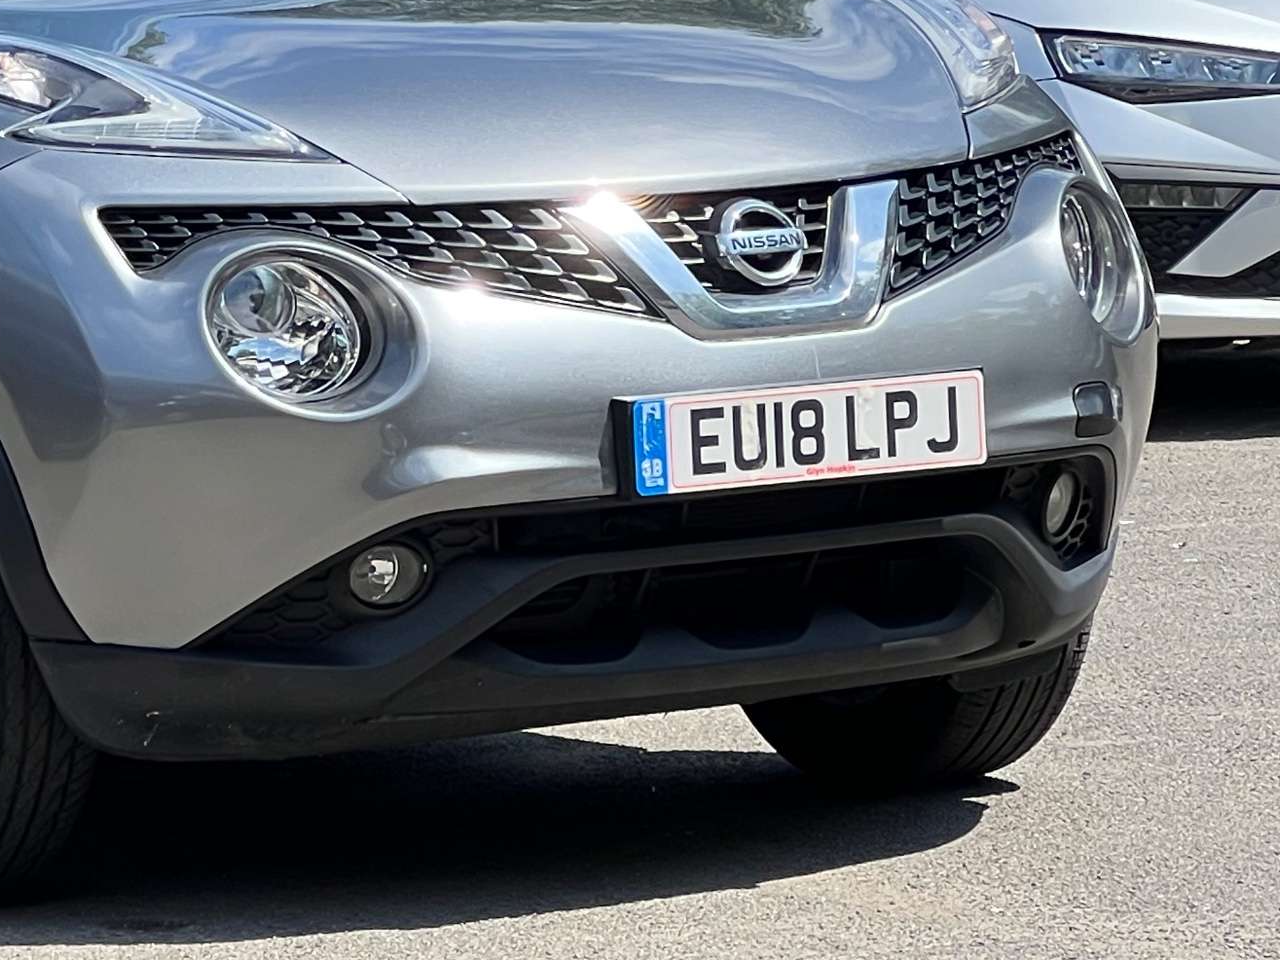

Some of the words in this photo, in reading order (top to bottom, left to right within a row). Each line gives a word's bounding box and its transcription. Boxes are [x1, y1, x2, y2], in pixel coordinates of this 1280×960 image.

[730, 232, 801, 250] NISSAN
[689, 399, 826, 476] EU18
[844, 386, 959, 462] LPJ
